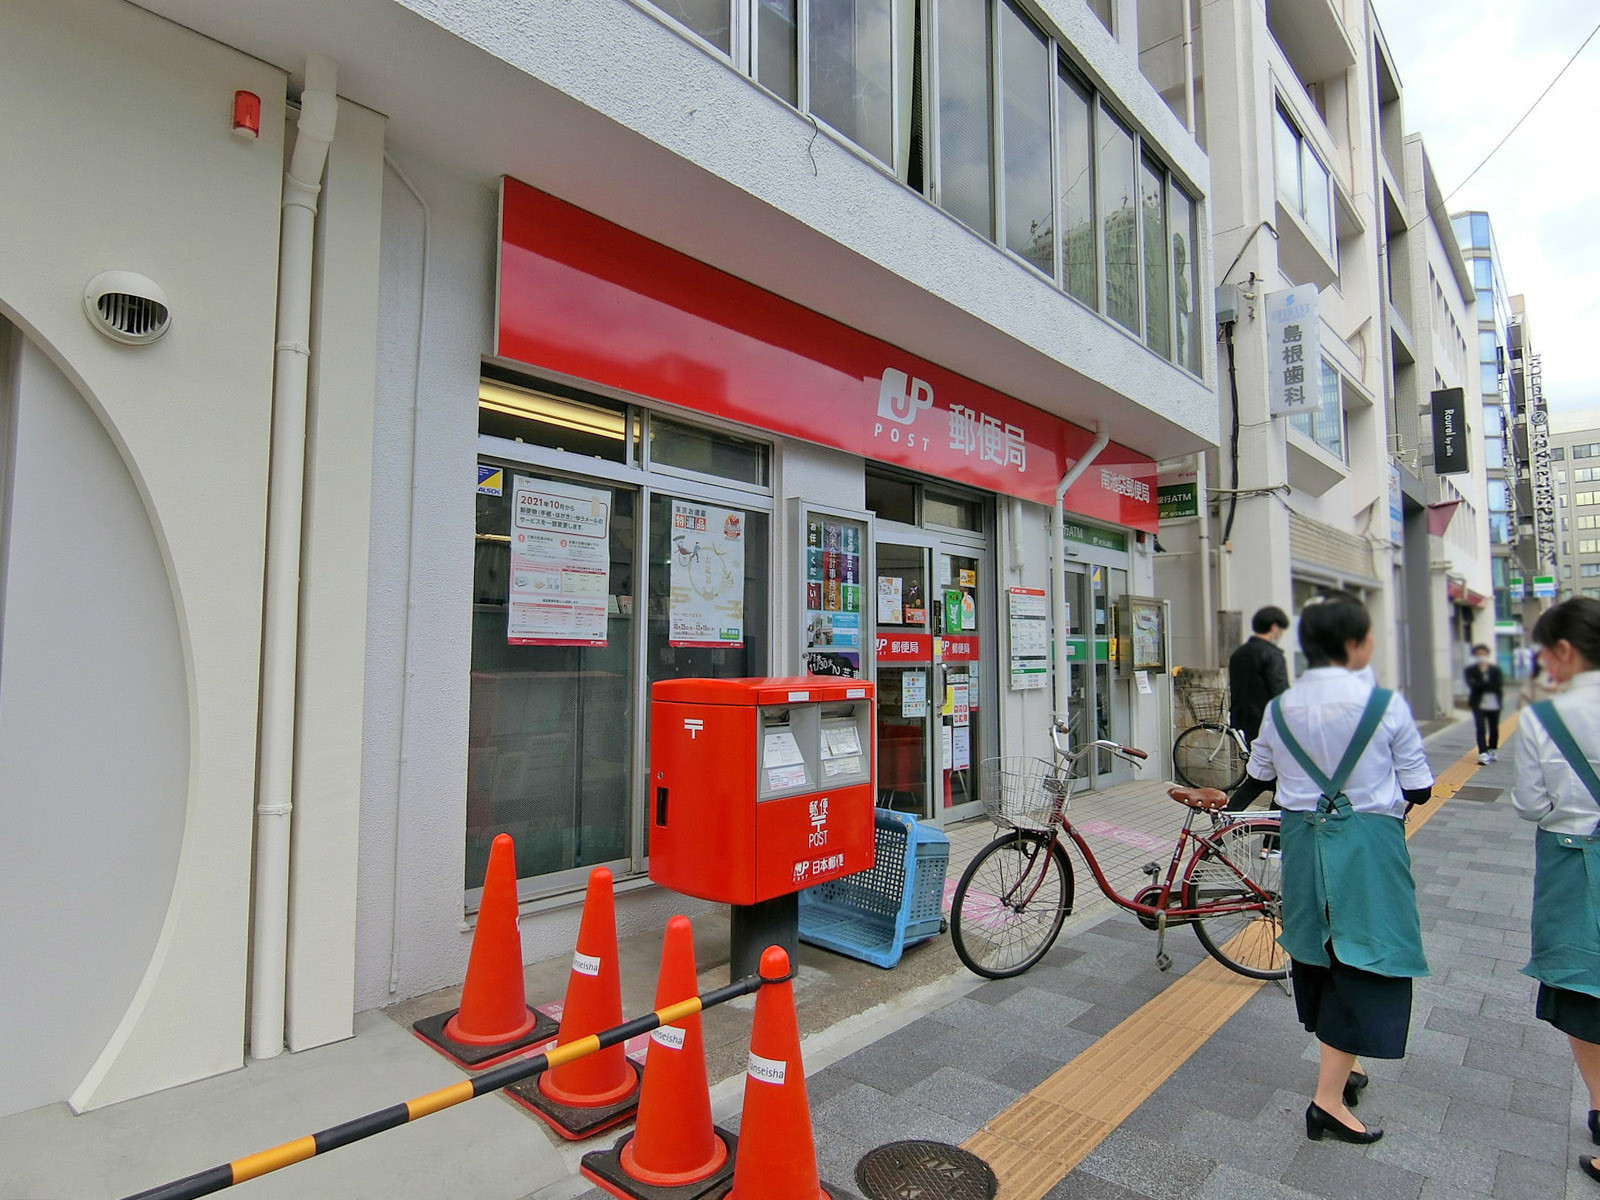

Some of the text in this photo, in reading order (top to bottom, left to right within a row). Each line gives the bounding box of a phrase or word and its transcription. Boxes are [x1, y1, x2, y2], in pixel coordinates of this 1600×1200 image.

[1282, 325, 1306, 407] 島根歯科
[874, 422, 930, 452] POST
[949, 403, 1027, 473] 郵便局
[477, 486, 501, 496] ALSOK
[520, 495, 576, 512] 2021年10月から
[891, 641, 919, 653] 郵便局
[952, 642, 970, 654] 郵便局
[809, 797, 829, 818] 郵便
[808, 829, 829, 849] POST
[812, 853, 844, 875] 日本郵便
